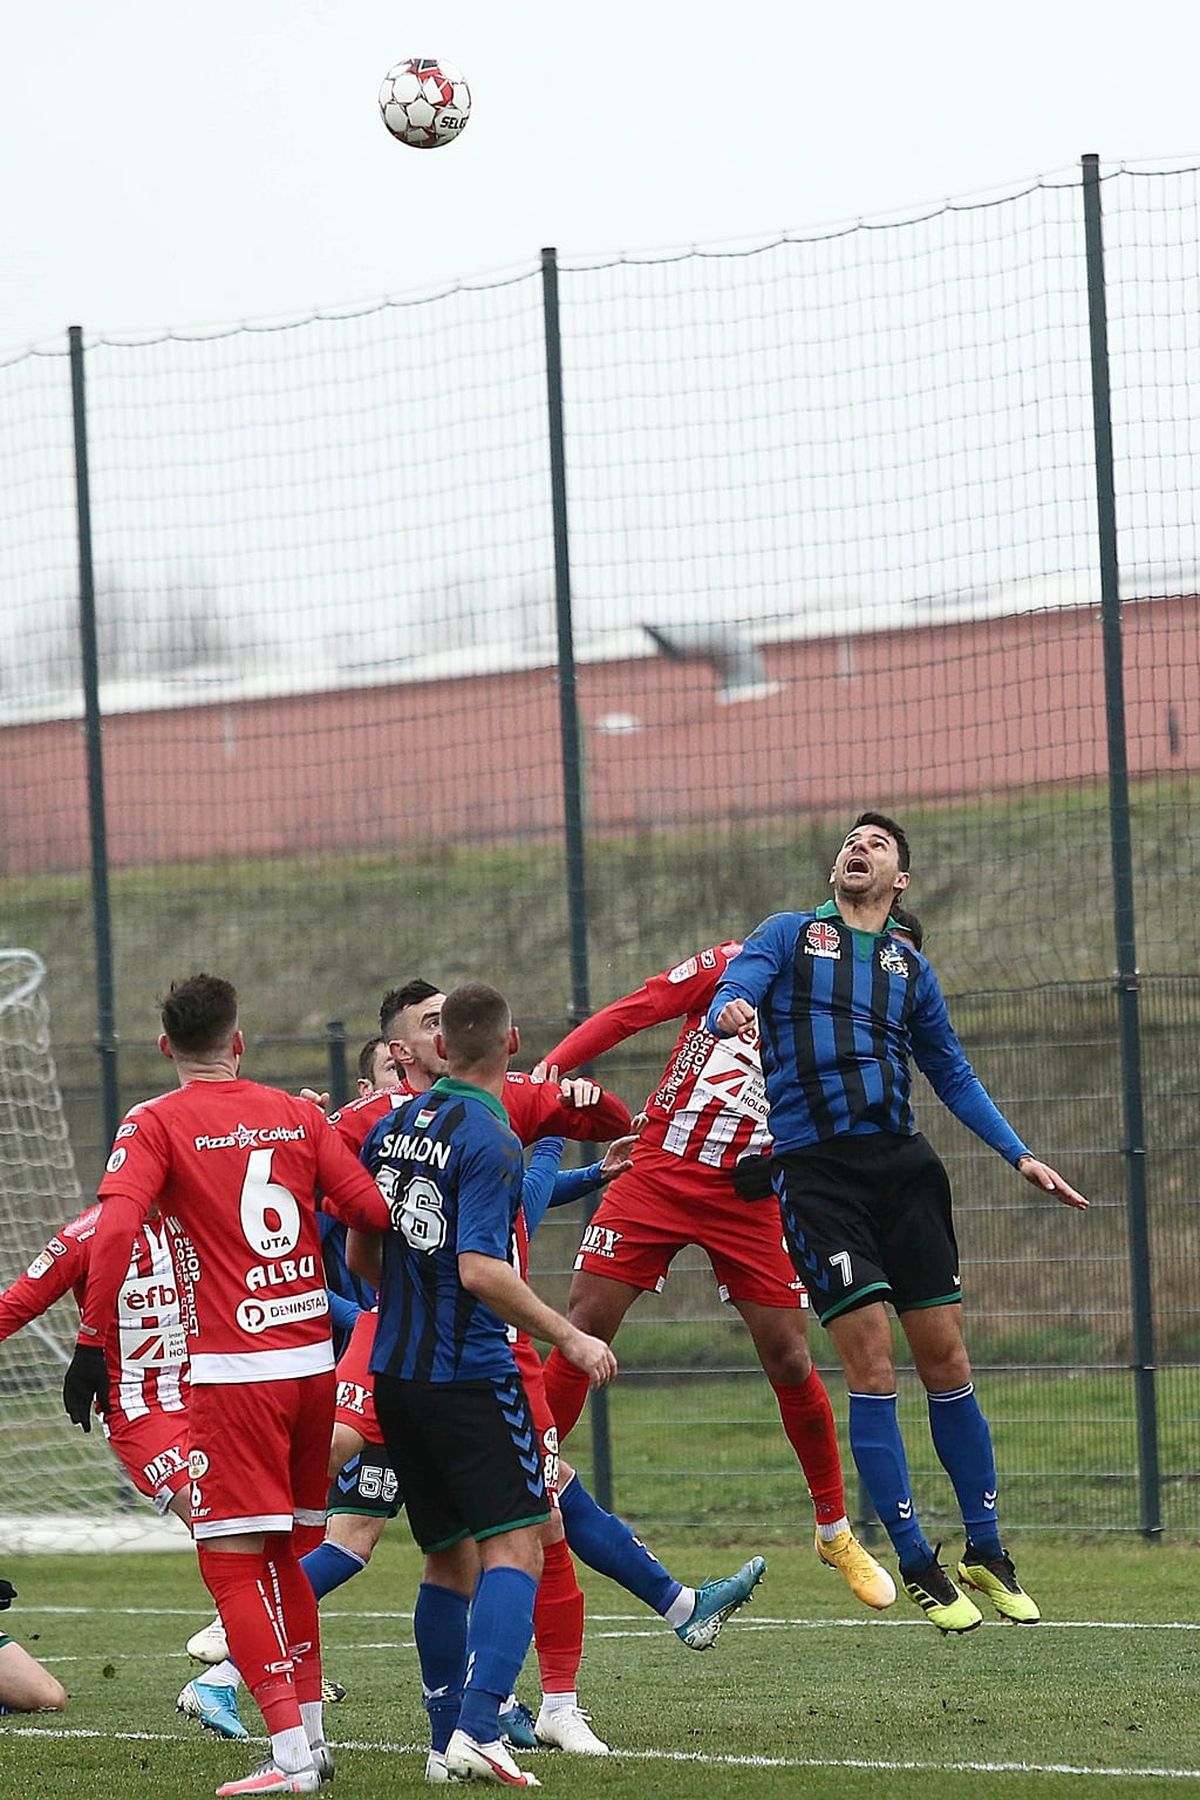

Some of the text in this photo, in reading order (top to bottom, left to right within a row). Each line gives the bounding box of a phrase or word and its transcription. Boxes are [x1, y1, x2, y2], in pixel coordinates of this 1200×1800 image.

[661, 1032, 704, 1113] CONSTRUCT
[692, 1034, 715, 1076] SHOP
[195, 1135, 236, 1151] Pizza
[378, 1134, 451, 1170] SIMON
[240, 1148, 300, 1259] 6
[183, 1237, 201, 1282] SHOP
[261, 1236, 291, 1250] UTA
[246, 1255, 315, 1292] ALBU
[829, 1250, 853, 1287] 7
[143, 1446, 185, 1485] DEY
[358, 1465, 399, 1502] 55
